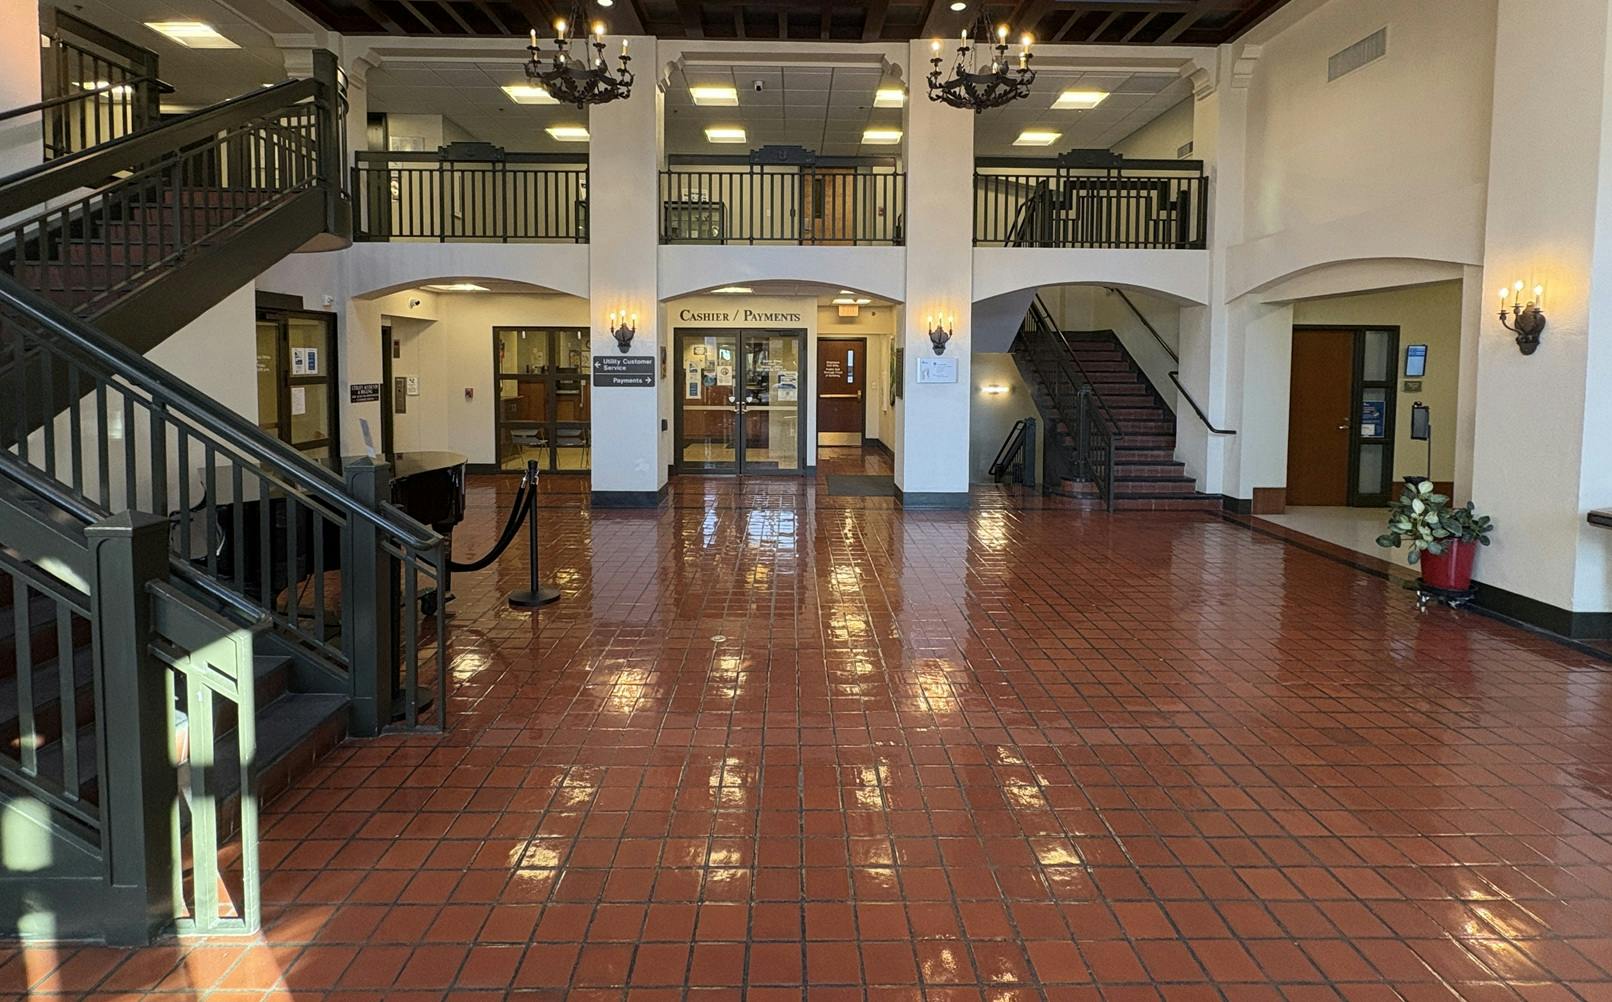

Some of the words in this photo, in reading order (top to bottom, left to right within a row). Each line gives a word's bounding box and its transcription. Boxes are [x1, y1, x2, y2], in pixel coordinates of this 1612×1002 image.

[679, 309, 730, 322] CASHIER
[733, 309, 740, 321] /
[743, 309, 801, 322] PAYMENTS
